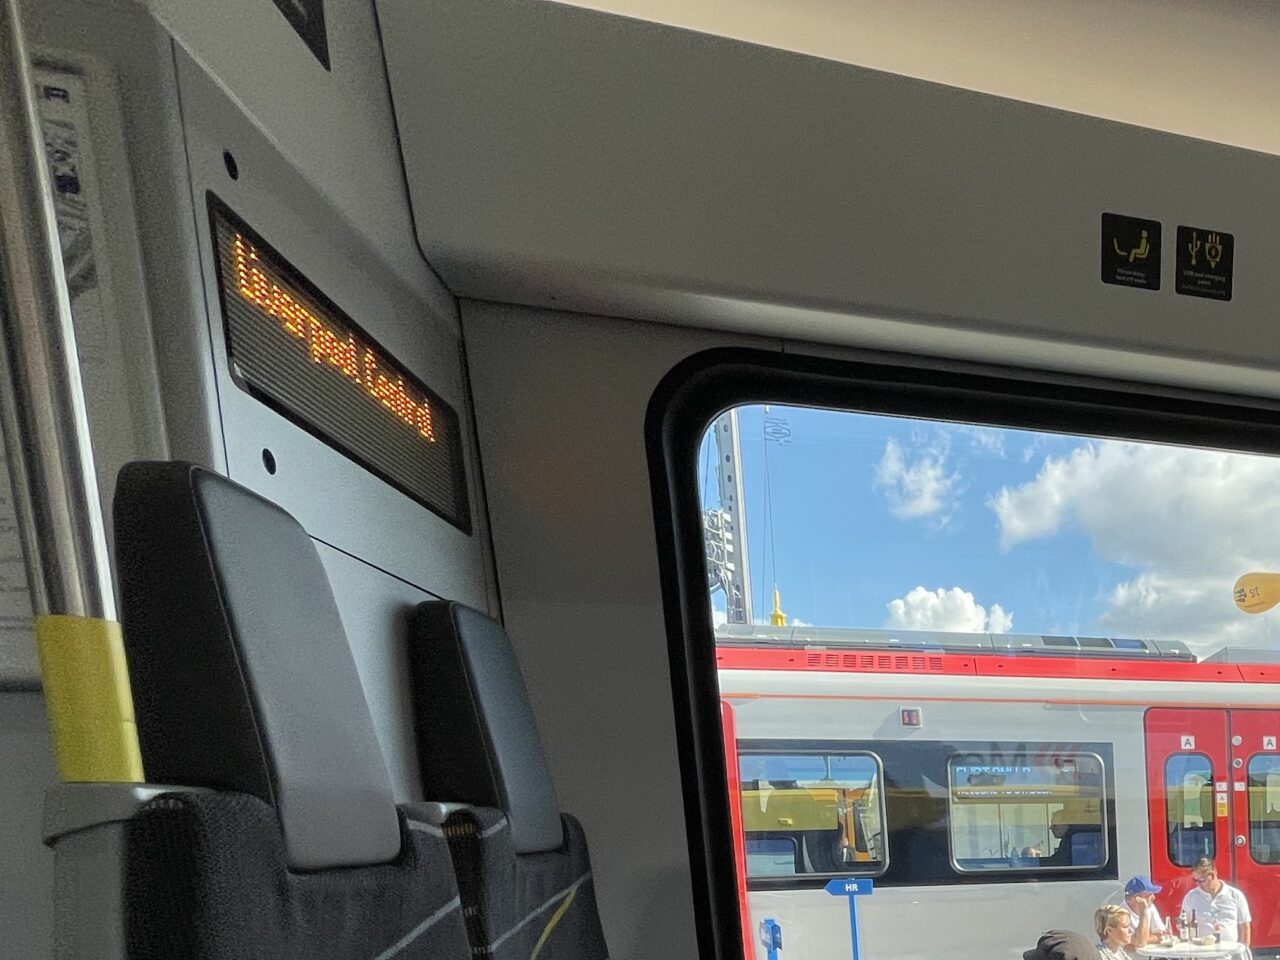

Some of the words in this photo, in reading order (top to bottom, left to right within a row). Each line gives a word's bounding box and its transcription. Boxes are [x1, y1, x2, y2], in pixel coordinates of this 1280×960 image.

[1184, 738, 1192, 747] A
[1266, 738, 1274, 747] A
[845, 883, 859, 892] HR
